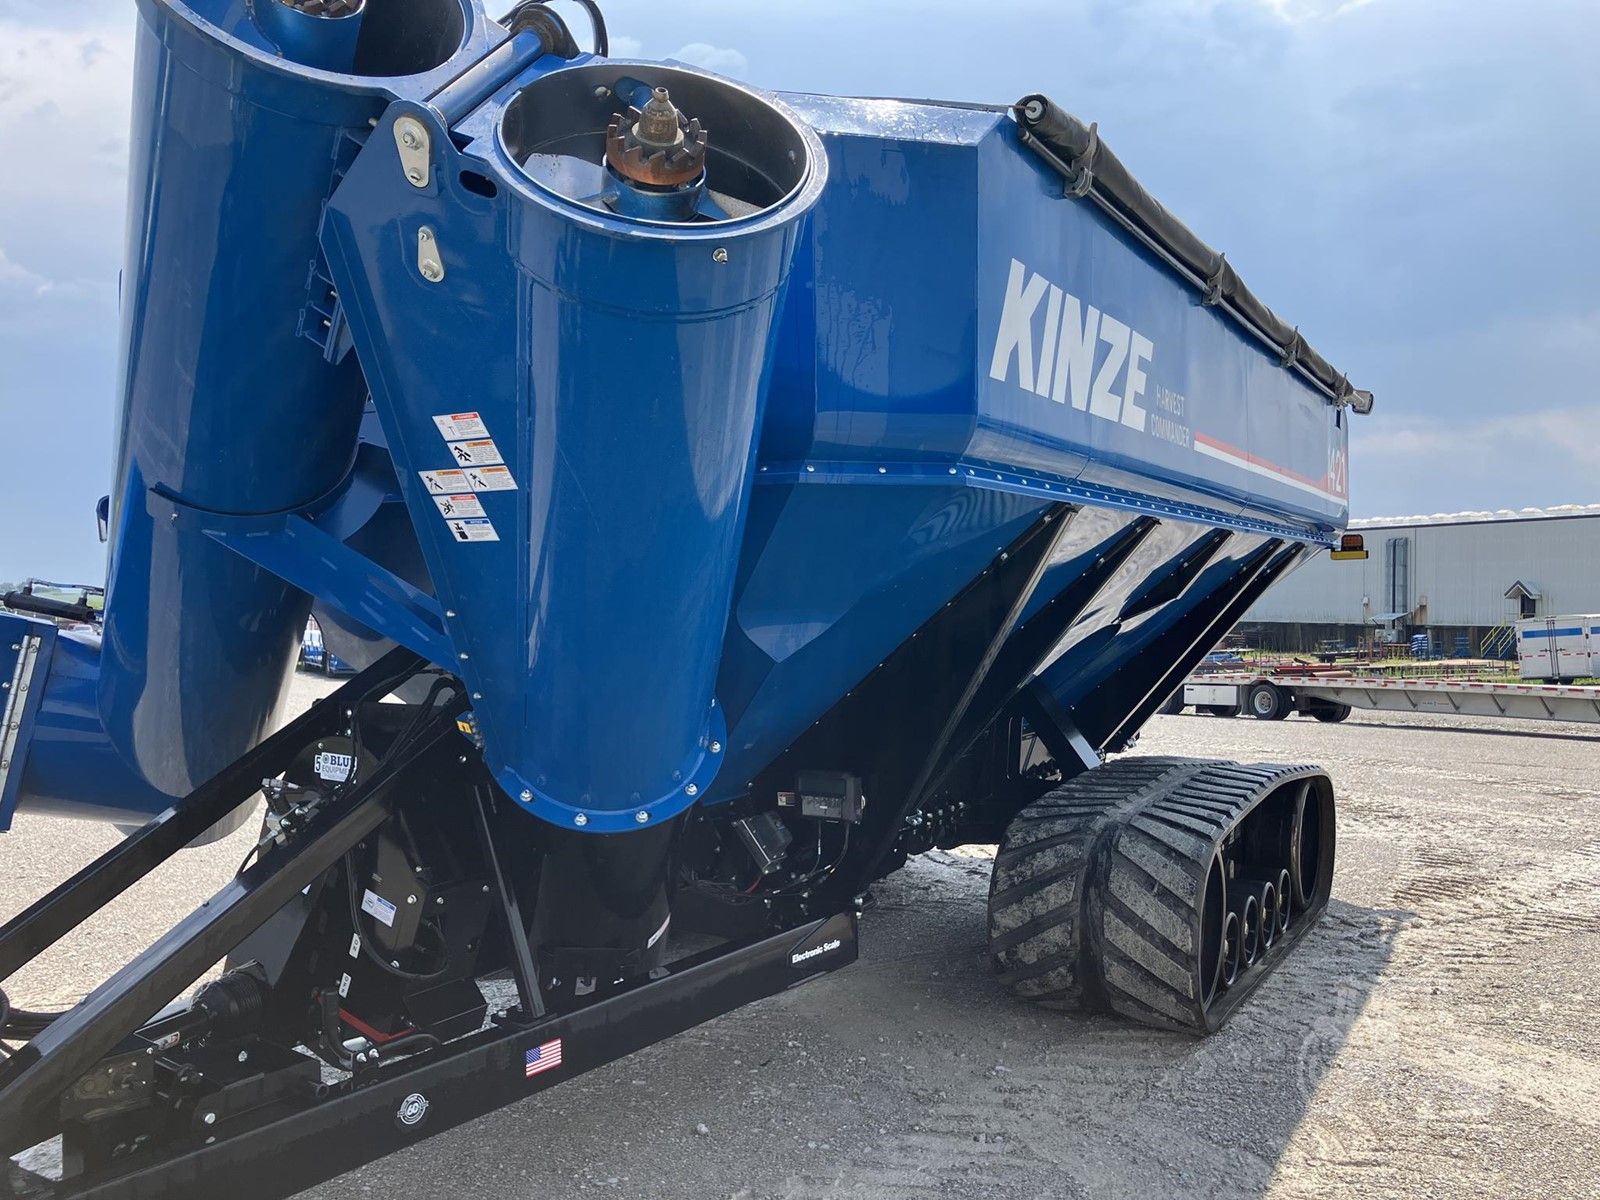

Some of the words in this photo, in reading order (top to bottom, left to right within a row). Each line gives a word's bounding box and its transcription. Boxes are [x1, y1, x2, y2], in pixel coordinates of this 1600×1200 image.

[989, 257, 1154, 432] KINZE
[1156, 384, 1185, 417] HARVEST
[1151, 413, 1190, 449] COMMANDER
[330, 755, 351, 767] BLU
[792, 945, 823, 964] Electronic
[823, 939, 841, 952] Scale
